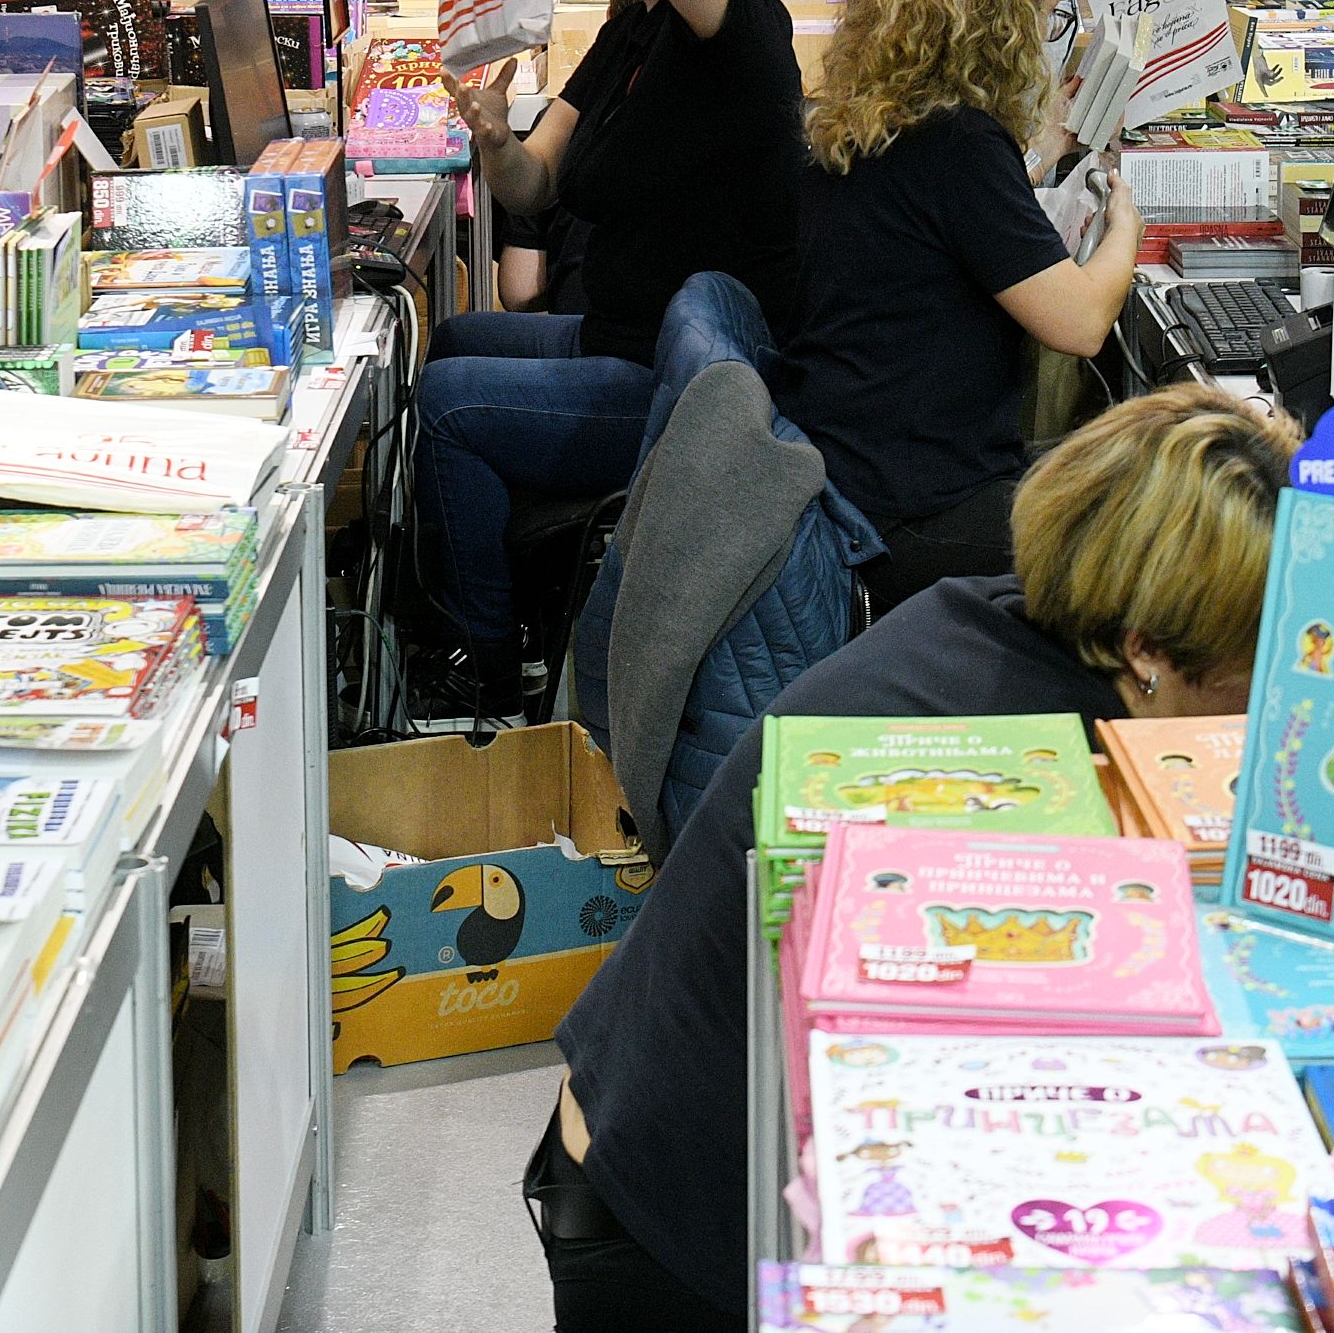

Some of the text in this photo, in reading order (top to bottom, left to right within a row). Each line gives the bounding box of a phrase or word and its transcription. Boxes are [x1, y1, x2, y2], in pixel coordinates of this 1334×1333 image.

[395, 60, 443, 74] прич
[390, 76, 443, 90] 101
[92, 179, 110, 209] 850
[298, 244, 322, 344] ИГРА ЗНАЊА
[1258, 832, 1302, 862] 1199
[954, 853, 1072, 872] ПРИЧЕ О
[1247, 869, 1306, 912] 1020
[1303, 888, 1332, 920] din.
[865, 960, 935, 984] 1020
[437, 980, 521, 1018] toco
